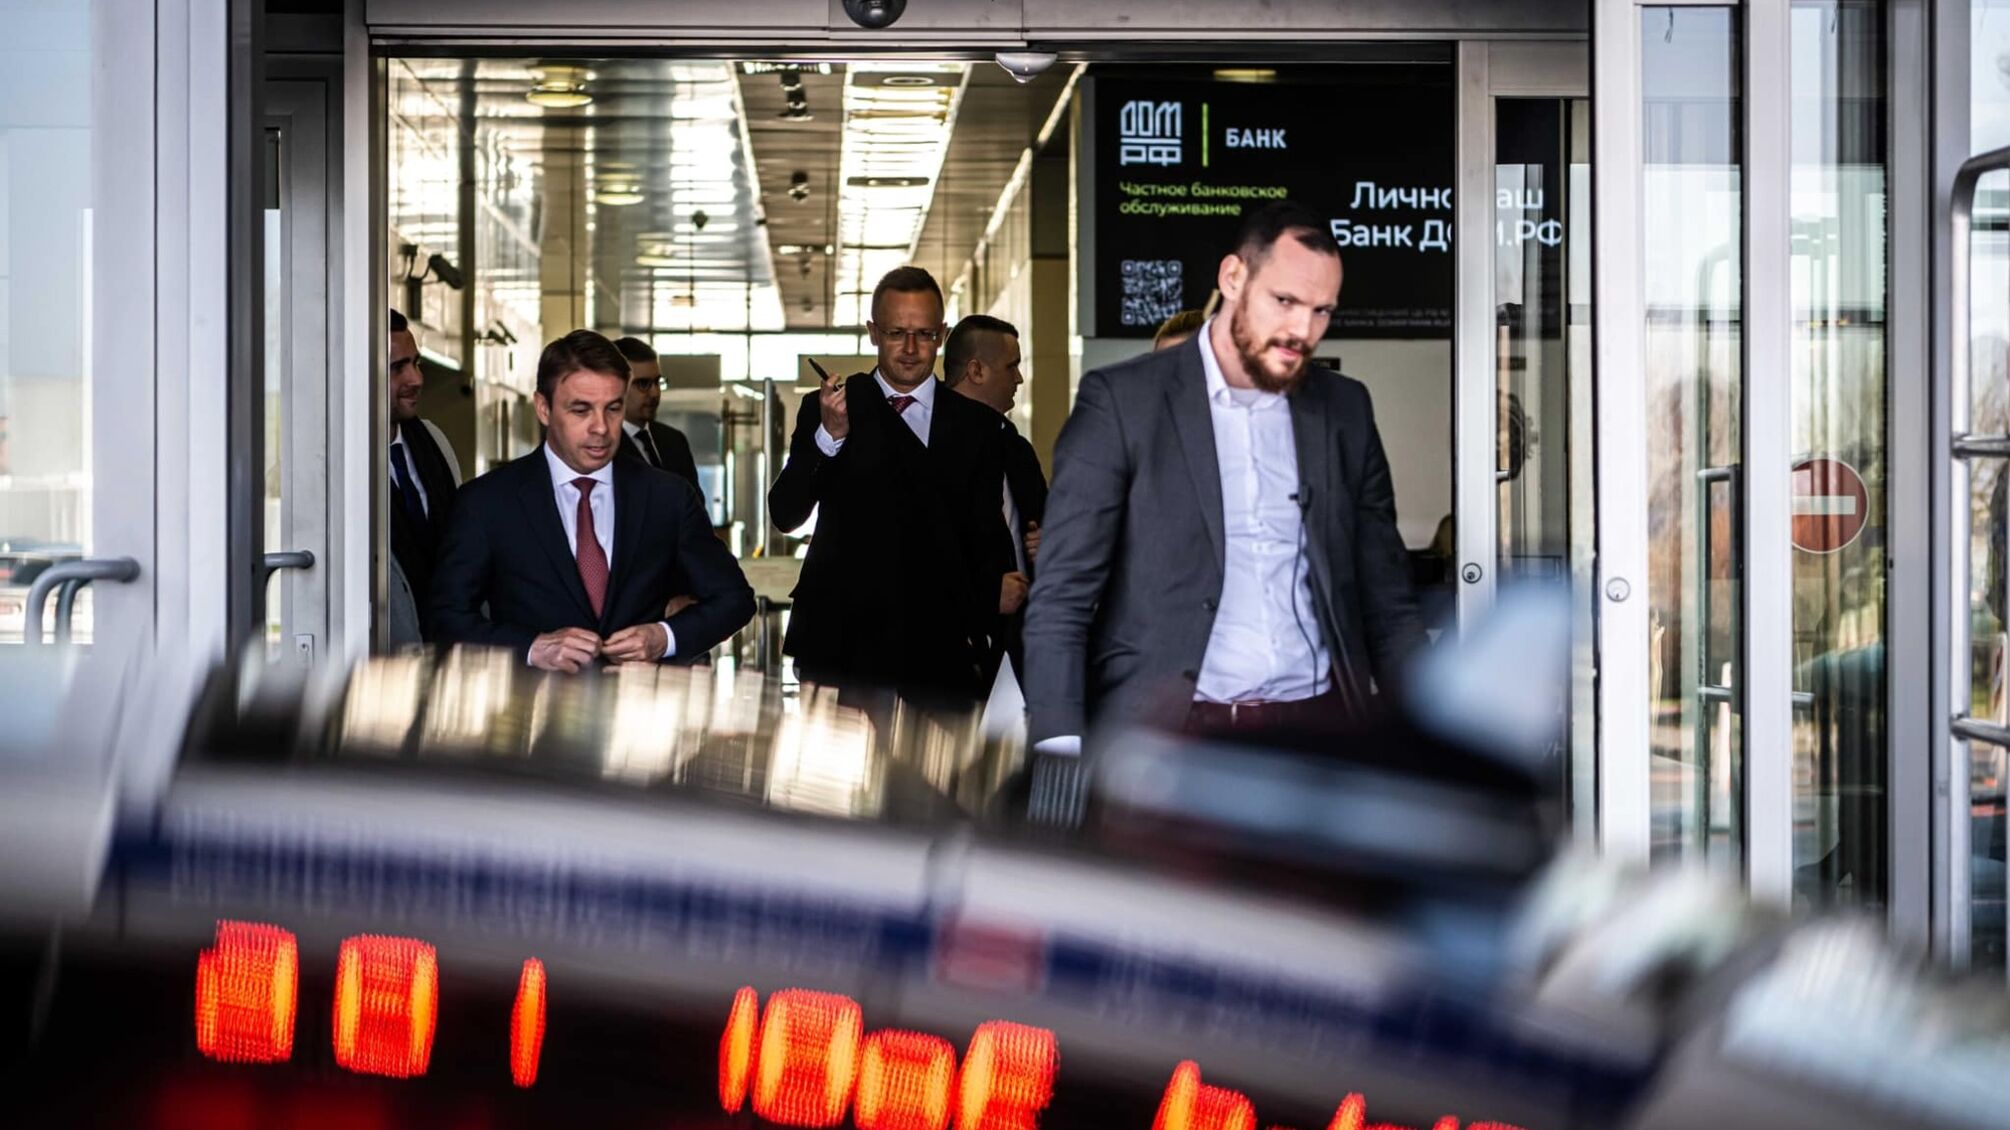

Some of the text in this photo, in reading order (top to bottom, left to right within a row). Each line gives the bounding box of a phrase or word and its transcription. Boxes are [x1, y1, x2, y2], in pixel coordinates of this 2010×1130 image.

[1120, 100, 1182, 137] ДОМ
[1225, 127, 1287, 149] БАНК
[1120, 145, 1182, 167] РФ
[1119, 181, 1288, 199] Частное банковское
[1496, 188, 1544, 210] аш
[1119, 198, 1242, 217] обслуживание
[1330, 219, 1413, 247] Банк
